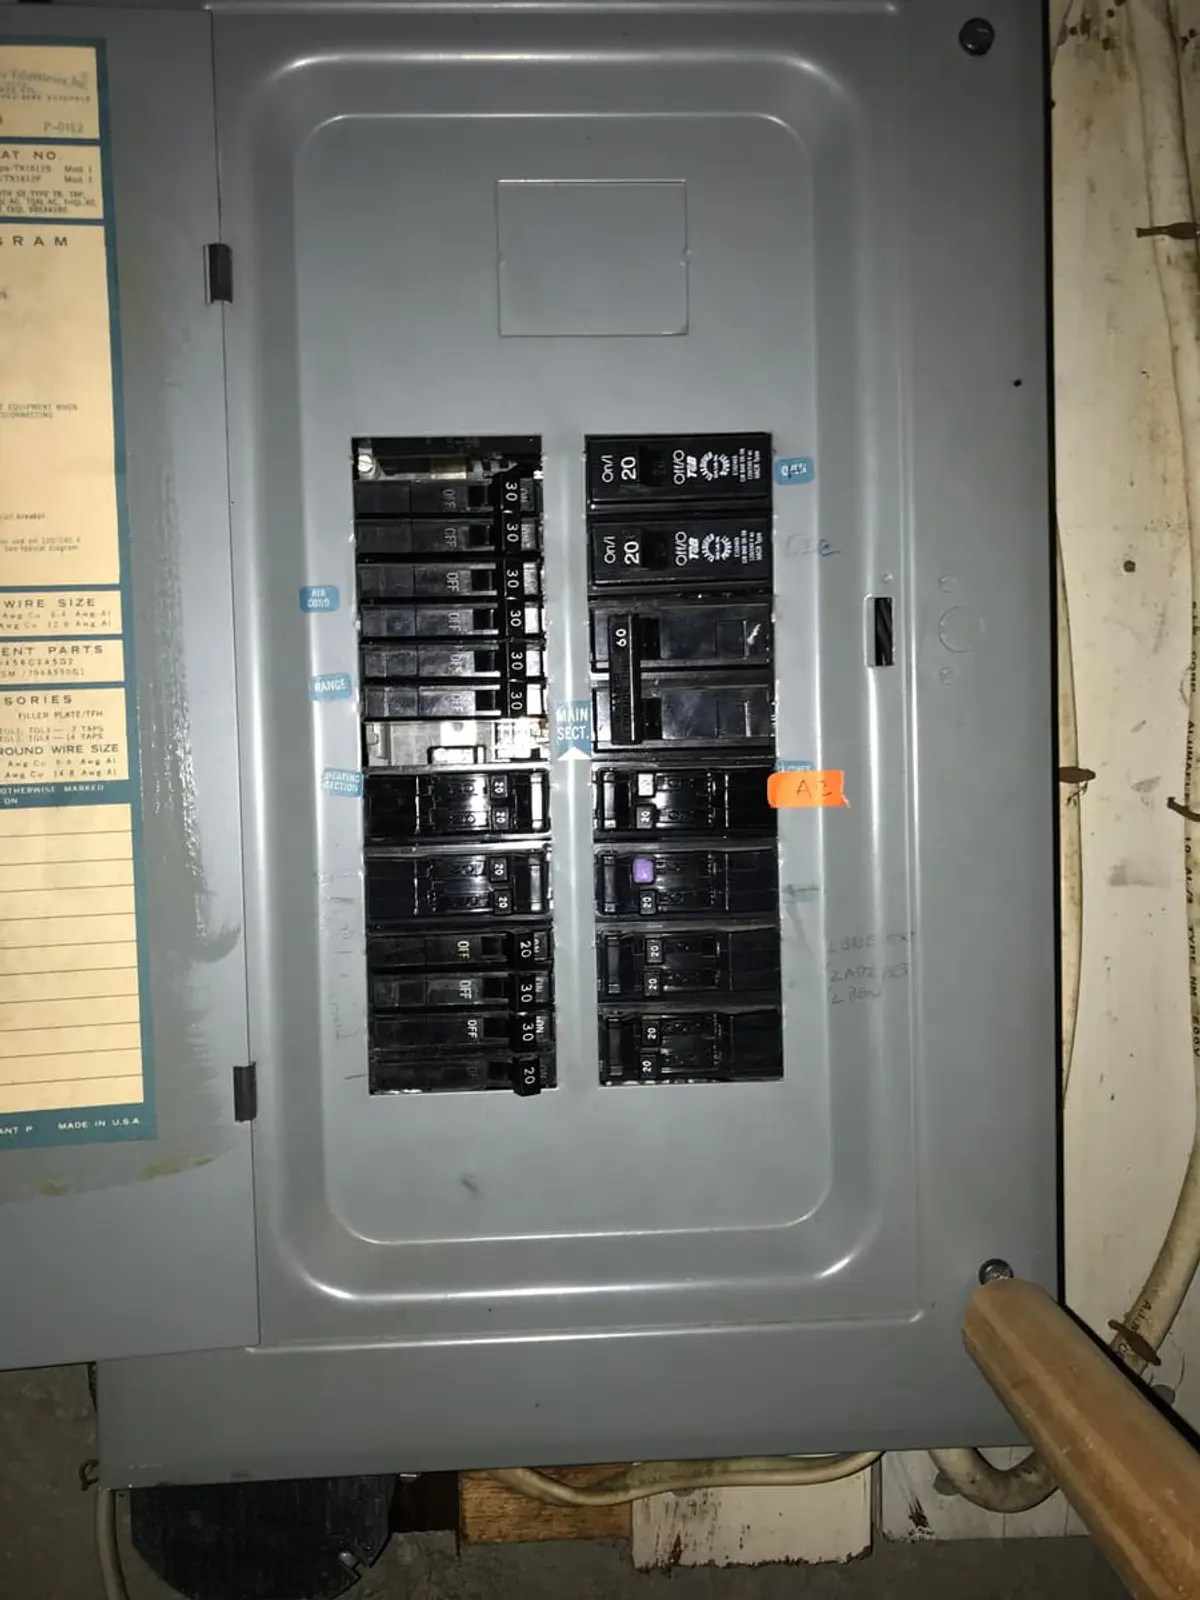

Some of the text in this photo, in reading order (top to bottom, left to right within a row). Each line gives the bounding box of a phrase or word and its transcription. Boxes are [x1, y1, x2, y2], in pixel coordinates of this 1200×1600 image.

[621, 456, 637, 480] 20
[443, 489, 456, 509] OFF
[505, 481, 519, 502] 30
[506, 523, 520, 543] 30
[624, 541, 640, 565] 20
[446, 572, 459, 592] OFF
[506, 568, 520, 588] 30
[4, 598, 95, 608] WIRE SIZE
[510, 610, 522, 627] 30
[615, 628, 627, 647] 60
[48, 645, 103, 654] PARTS
[511, 652, 523, 671] 30
[314, 678, 347, 693] RANGE
[4, 695, 72, 706] SORIES
[511, 691, 523, 710] 30
[556, 707, 588, 722] MAIN
[557, 725, 590, 740] SECT.
[51, 744, 84, 754] WIRE
[91, 743, 118, 753] SIZE
[64, 783, 104, 792] MARKED
[494, 863, 504, 876] 20
[498, 896, 508, 909] 20
[642, 896, 652, 908] 20
[457, 940, 470, 959] OFF
[519, 940, 532, 958] 20
[650, 945, 660, 957] 20
[459, 979, 472, 1000] OFF
[648, 978, 658, 991] 20
[520, 984, 533, 1003] 30
[467, 1019, 478, 1039] OFF
[522, 1023, 535, 1042] 30
[647, 1027, 657, 1040] 20
[642, 1060, 652, 1073] 20
[524, 1067, 536, 1085] 20
[58, 1121, 88, 1130] MADE
[95, 1119, 106, 1128] IN
